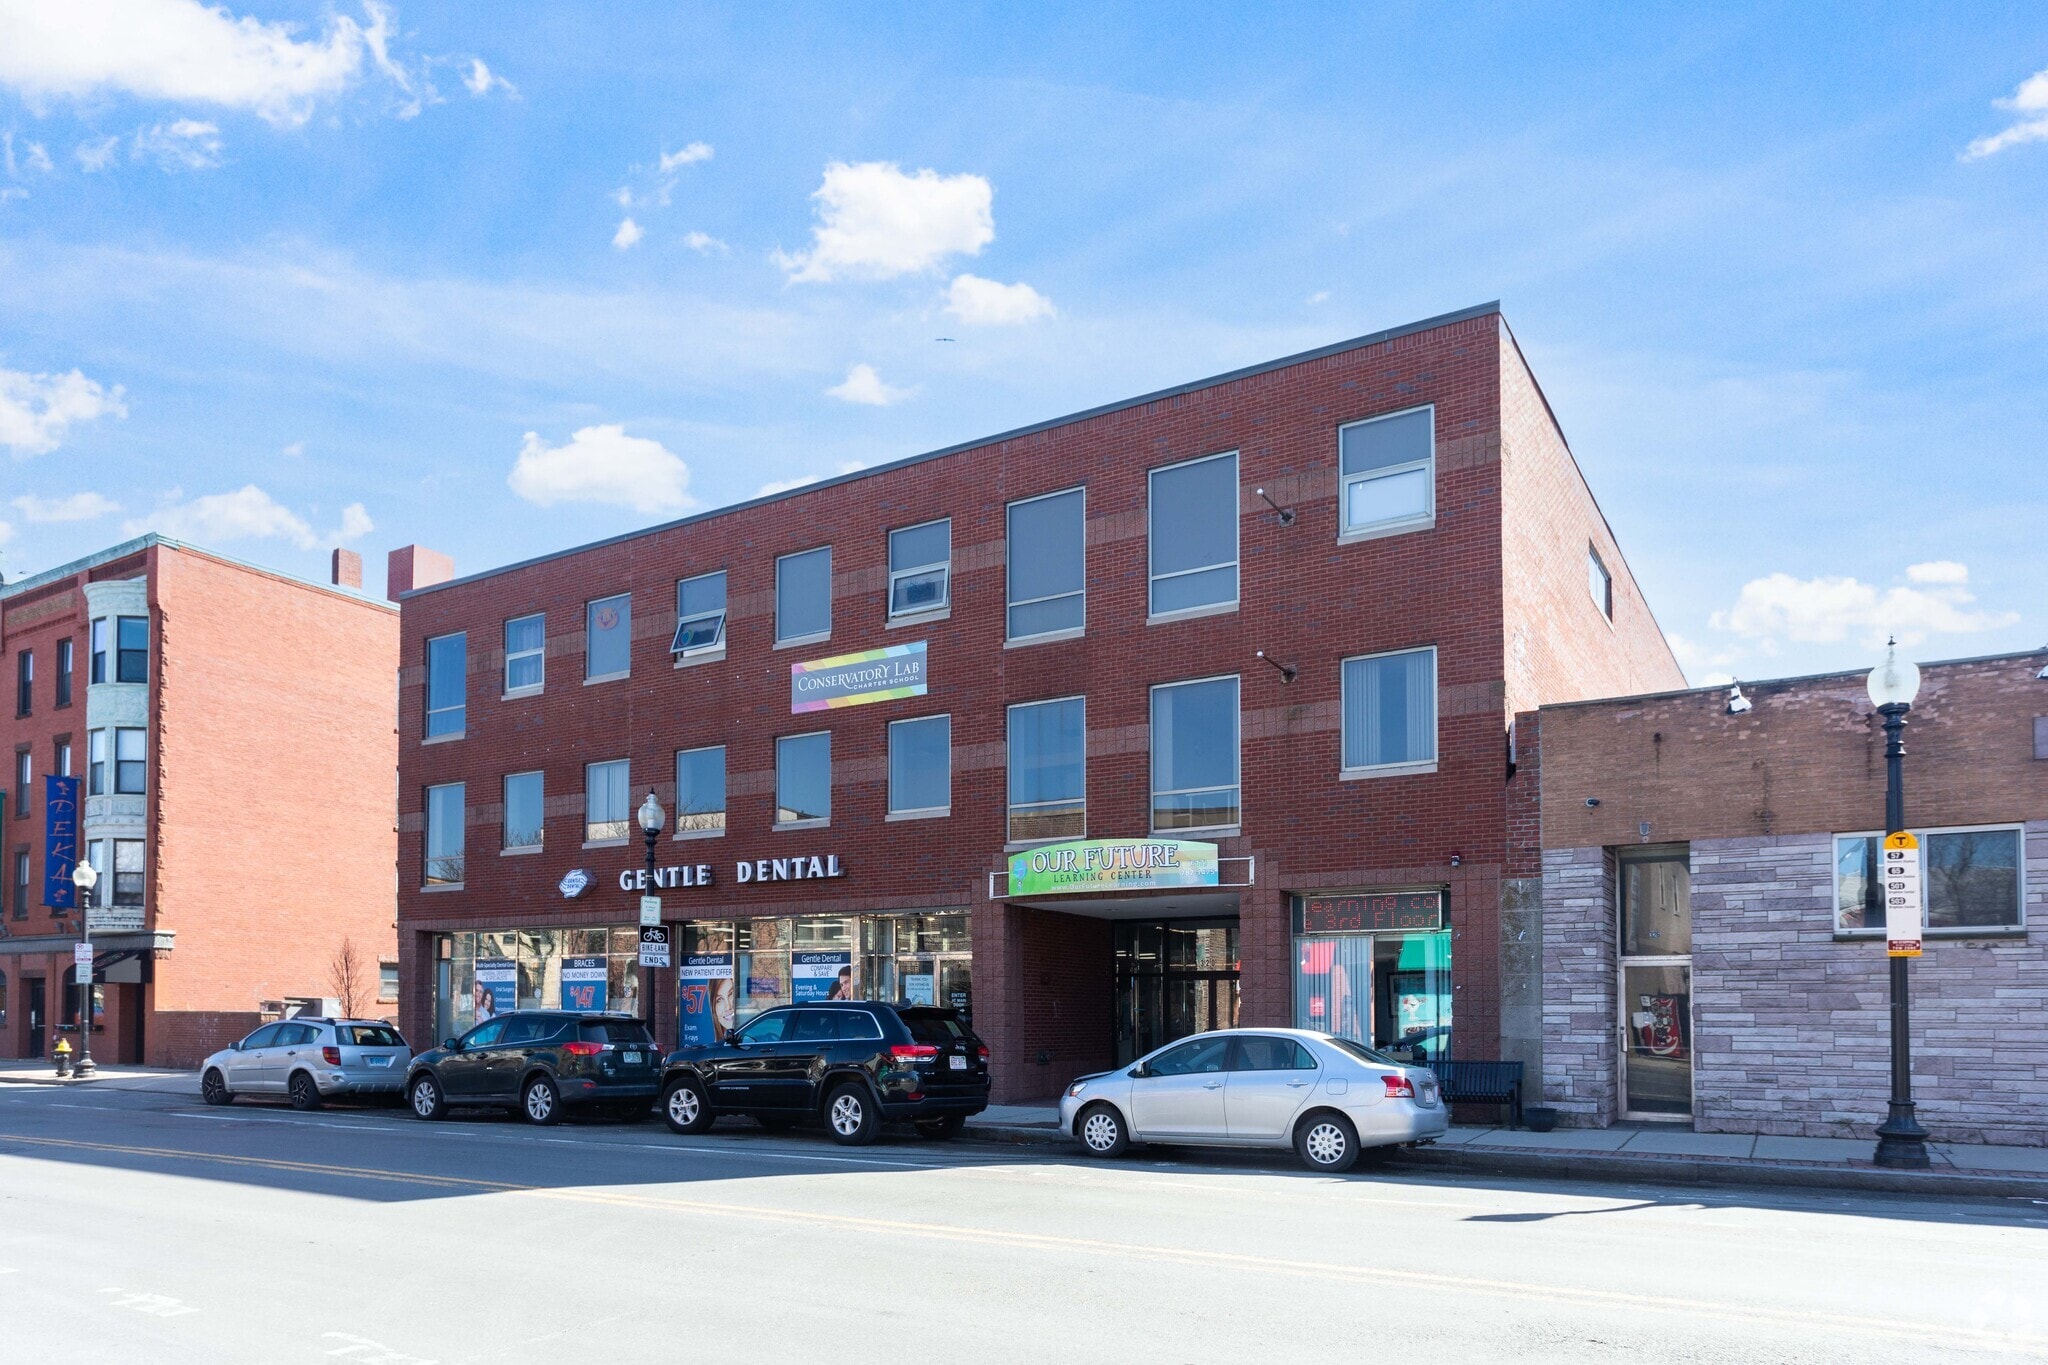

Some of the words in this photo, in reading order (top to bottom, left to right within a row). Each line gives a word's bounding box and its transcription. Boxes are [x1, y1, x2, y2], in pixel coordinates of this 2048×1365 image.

[798, 664, 891, 691] CONSERVATORY
[895, 661, 920, 676] LAB
[853, 680, 887, 690] CHARTER
[889, 675, 920, 685] SCHOOL
[49, 799, 76, 884] DEKA
[1895, 836, 1906, 845] T
[1032, 849, 1079, 874] OUR
[1083, 844, 1180, 871] FUTURE
[619, 864, 709, 891] GENTLE
[736, 854, 842, 883] DENTAL
[1054, 872, 1103, 883] LEARNING
[1110, 869, 1152, 880] CENTER
[1051, 880, 1157, 891] www.OurFutureLearning.com
[1306, 896, 1440, 913] earning.co
[1326, 912, 1361, 929] 3rd
[1374, 911, 1438, 928] Floor
[574, 959, 595, 967] BRACES
[644, 956, 664, 964] ENDS
[688, 957, 706, 965] Gentle
[706, 956, 725, 965] Dental
[801, 954, 821, 963] Gentle
[821, 954, 842, 963] Dental
[590, 971, 606, 979] DOWN
[681, 969, 694, 977] NEW
[716, 968, 732, 976] OFFER
[570, 986, 595, 1008] $147
[682, 984, 707, 1014] $57
[684, 1023, 697, 1031] Exam
[684, 1034, 699, 1042] X-rays
